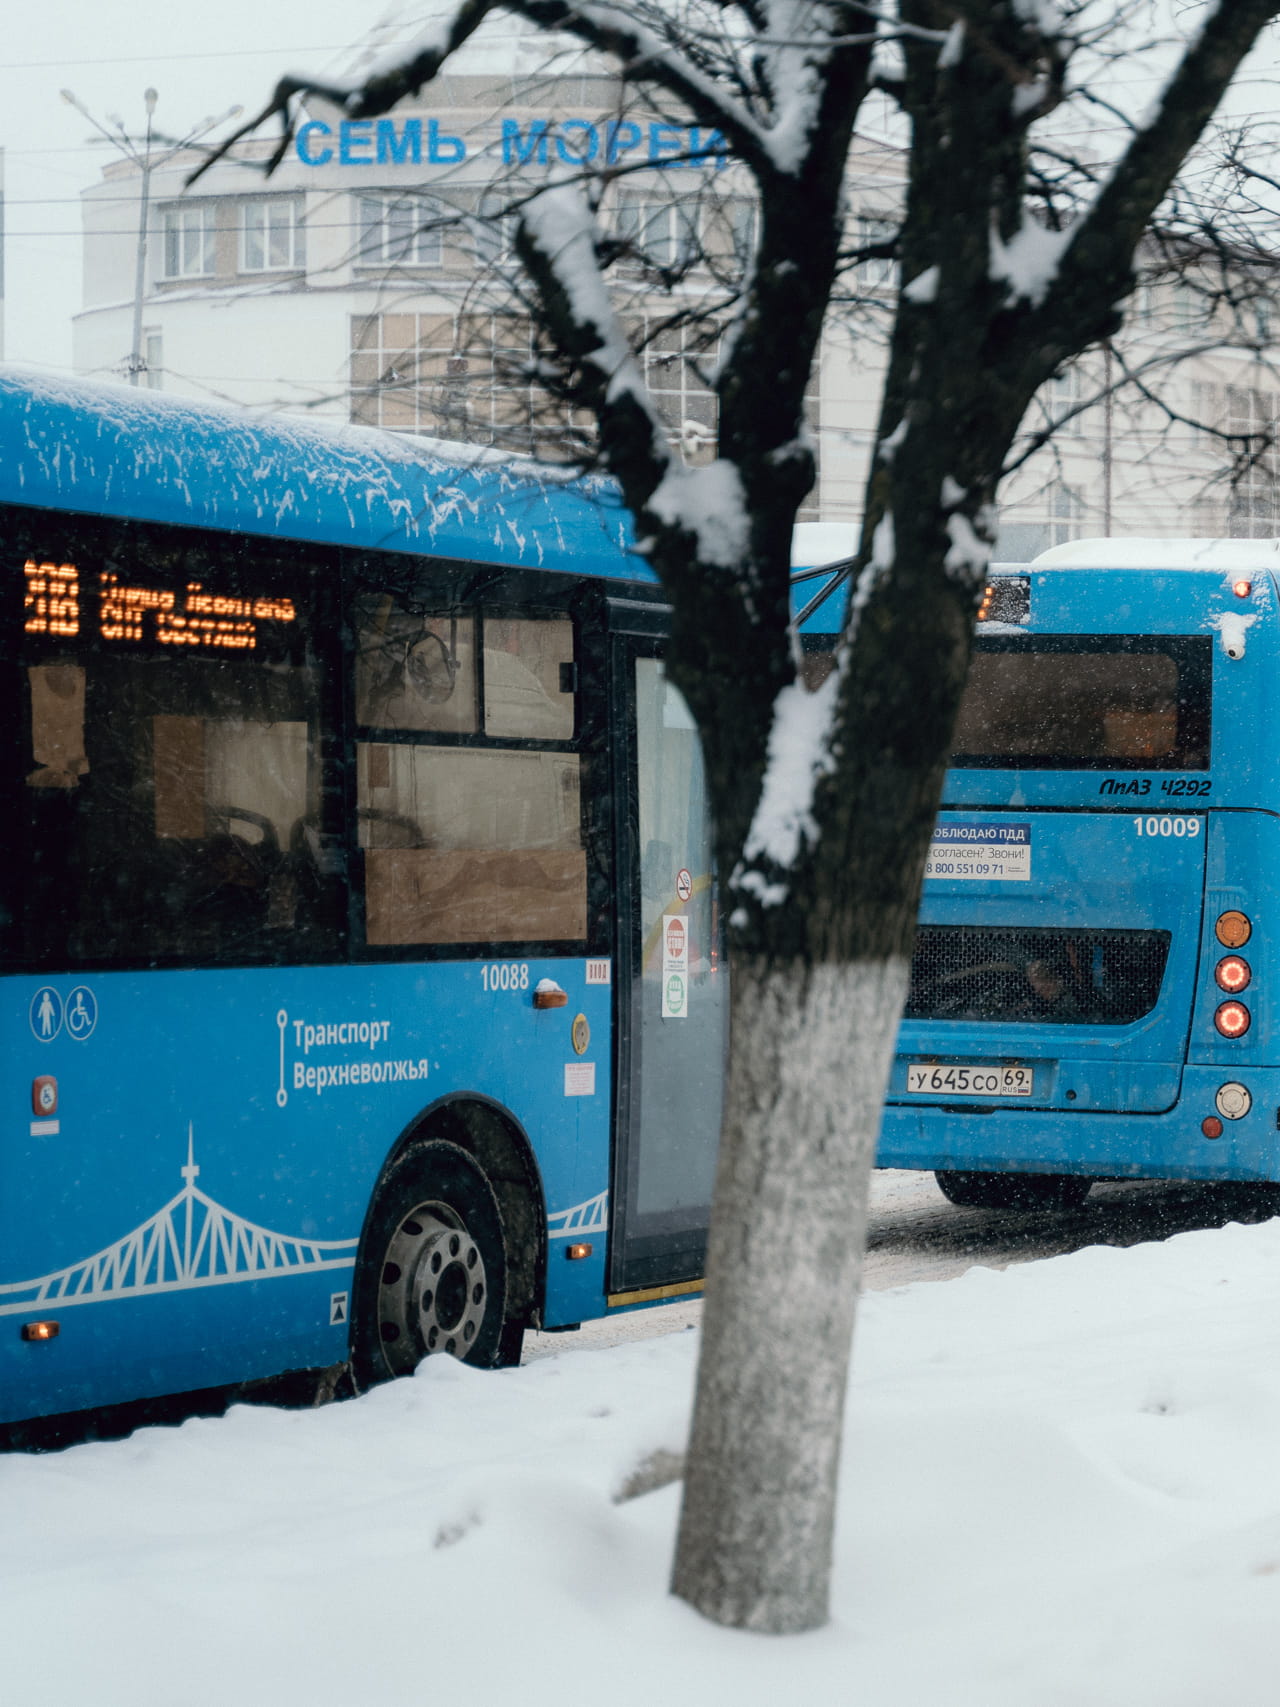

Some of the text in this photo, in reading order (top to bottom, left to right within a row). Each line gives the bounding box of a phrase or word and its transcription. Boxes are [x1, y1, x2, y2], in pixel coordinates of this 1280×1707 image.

[296, 118, 467, 167] СЕМЬ
[1160, 780, 1212, 796] 4292
[934, 828, 1025, 841] ОБЛЮДАЮ ПДД
[1133, 817, 1200, 837] 10009
[932, 847, 985, 860] согласен?
[988, 848, 1025, 859] Звони!
[926, 863, 933, 873] 8
[935, 863, 954, 873] 800
[956, 864, 974, 874] 551
[976, 864, 990, 874] 09
[992, 864, 1004, 874] 71
[480, 963, 529, 992] 10088
[293, 1020, 391, 1054] Транспорт
[293, 1059, 428, 1095] Верхневолжья
[1004, 1070, 1025, 1086] 69
